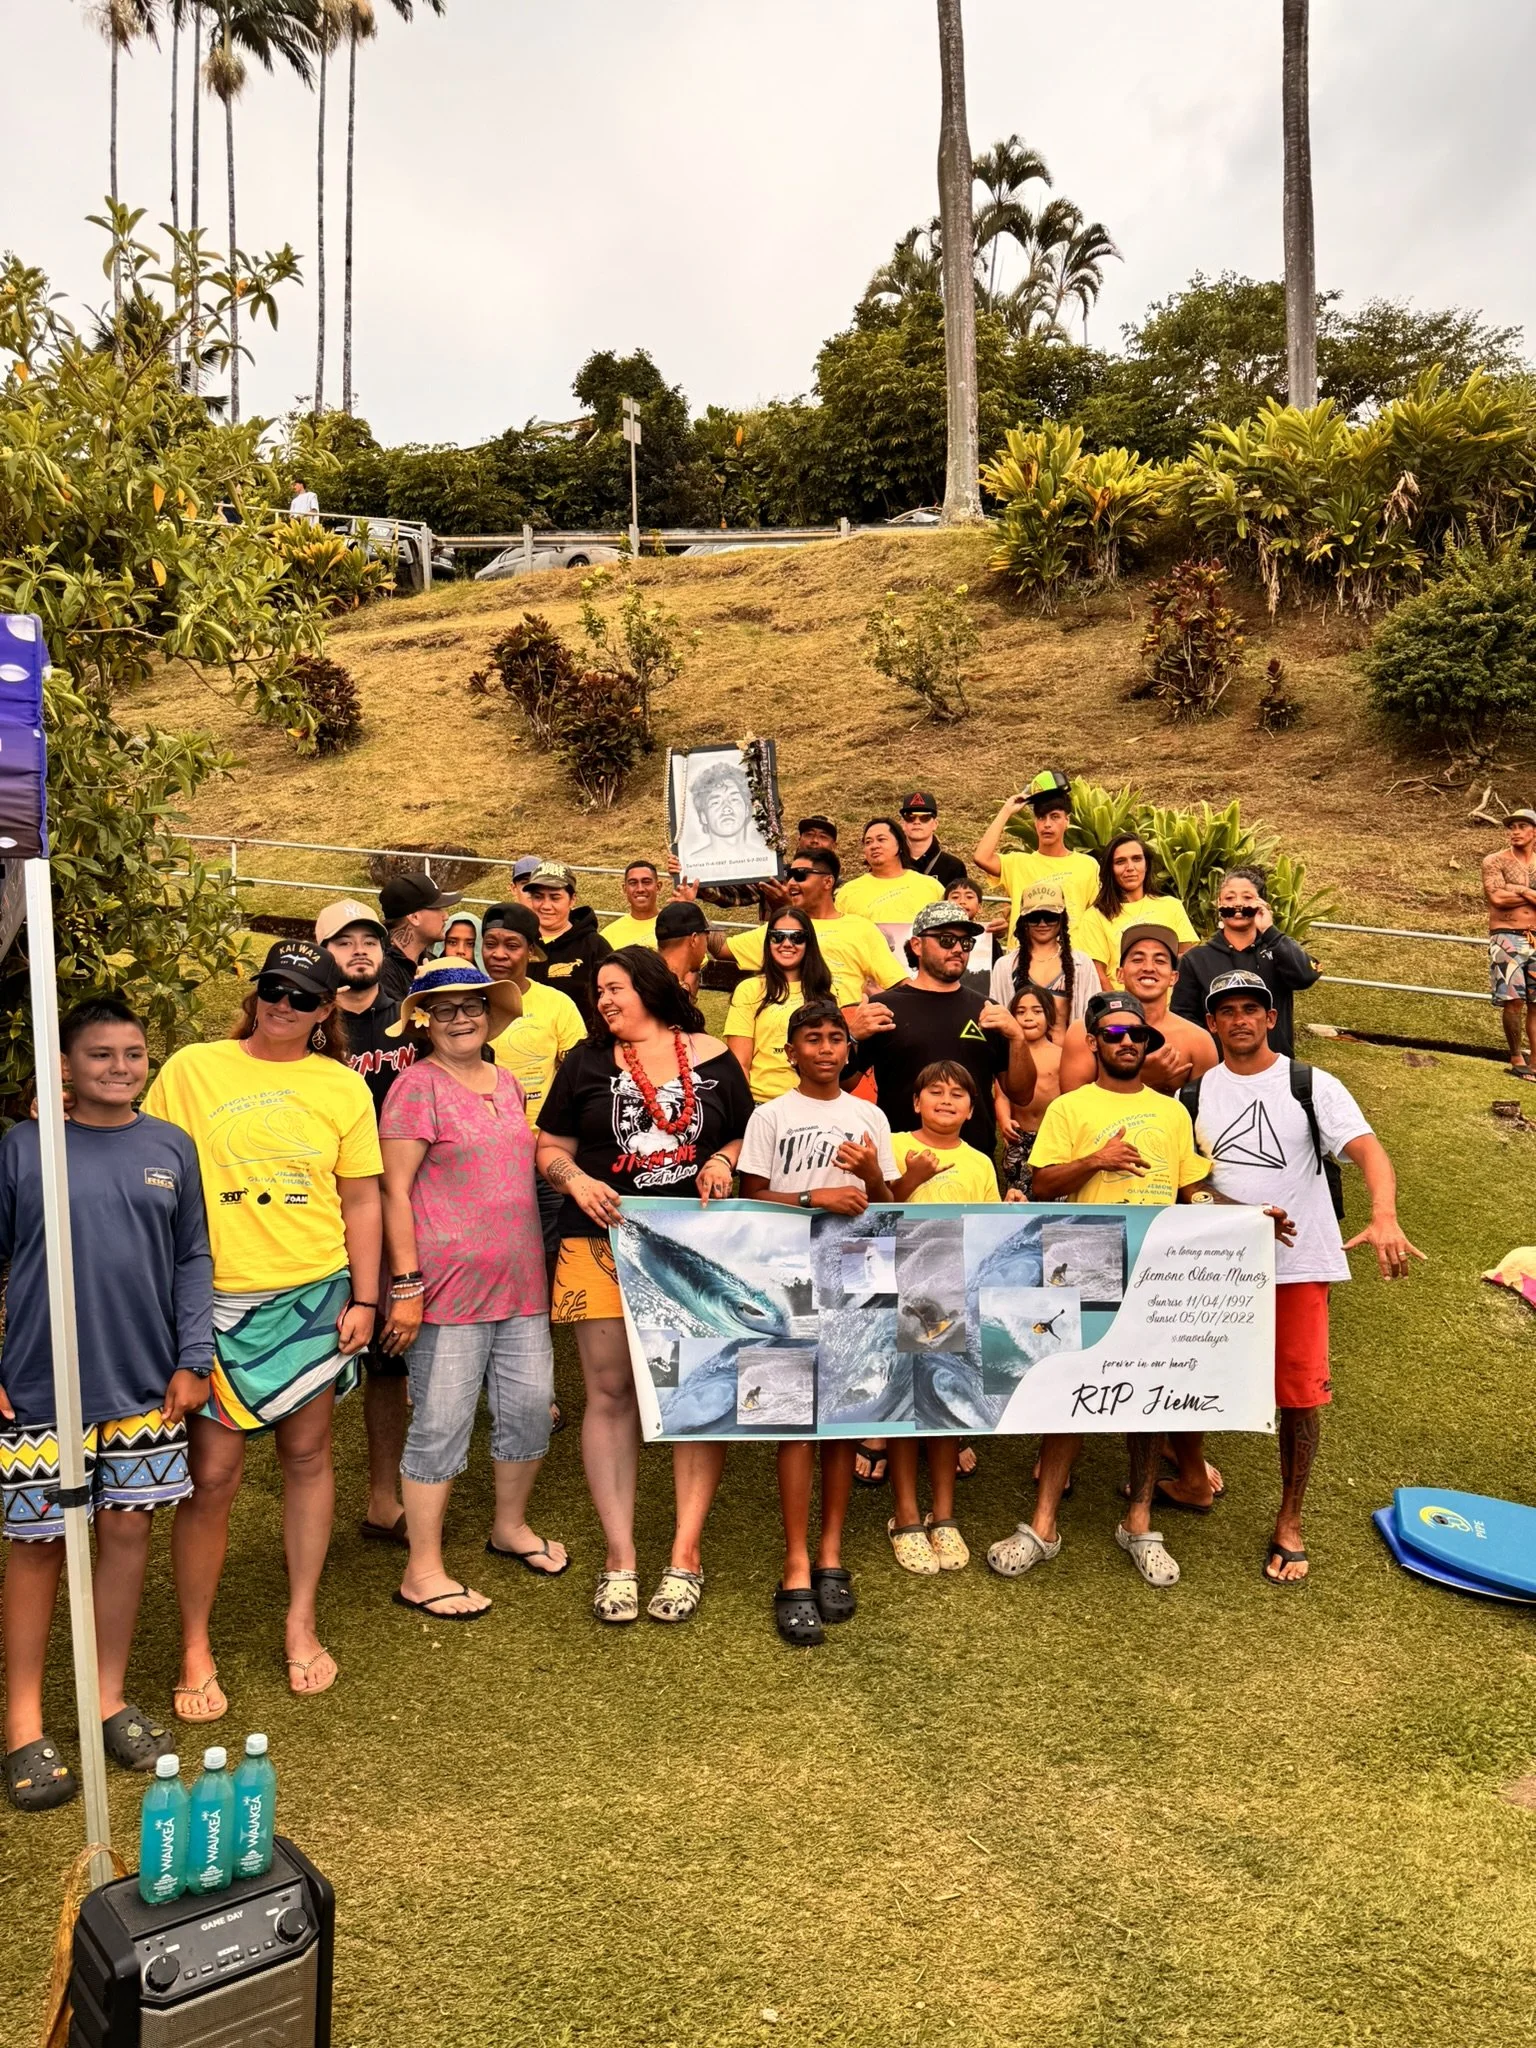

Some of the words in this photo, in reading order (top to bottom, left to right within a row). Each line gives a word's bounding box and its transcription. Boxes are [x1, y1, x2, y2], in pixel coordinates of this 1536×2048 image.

[280, 943, 296, 955] KAI
[1164, 1246, 1177, 1258] In
[1178, 1245, 1203, 1260] loving
[1204, 1248, 1235, 1261] memory
[1236, 1246, 1248, 1262] of
[1133, 1266, 1185, 1289] Jiemone
[1147, 1294, 1183, 1308] Sunrise
[1186, 1293, 1255, 1310] 11/04/1997
[1146, 1310, 1178, 1324] Sunset
[1179, 1310, 1255, 1326] 05/07/2022
[1102, 1358, 1135, 1375] forever
[1137, 1358, 1148, 1368] in
[1150, 1361, 1167, 1369] our
[1168, 1357, 1199, 1372] hearts
[1071, 1381, 1135, 1418] RIP
[1142, 1384, 1225, 1416] Jiemz
[201, 1916, 227, 1932] GAME
[226, 1909, 245, 1923] DAY
